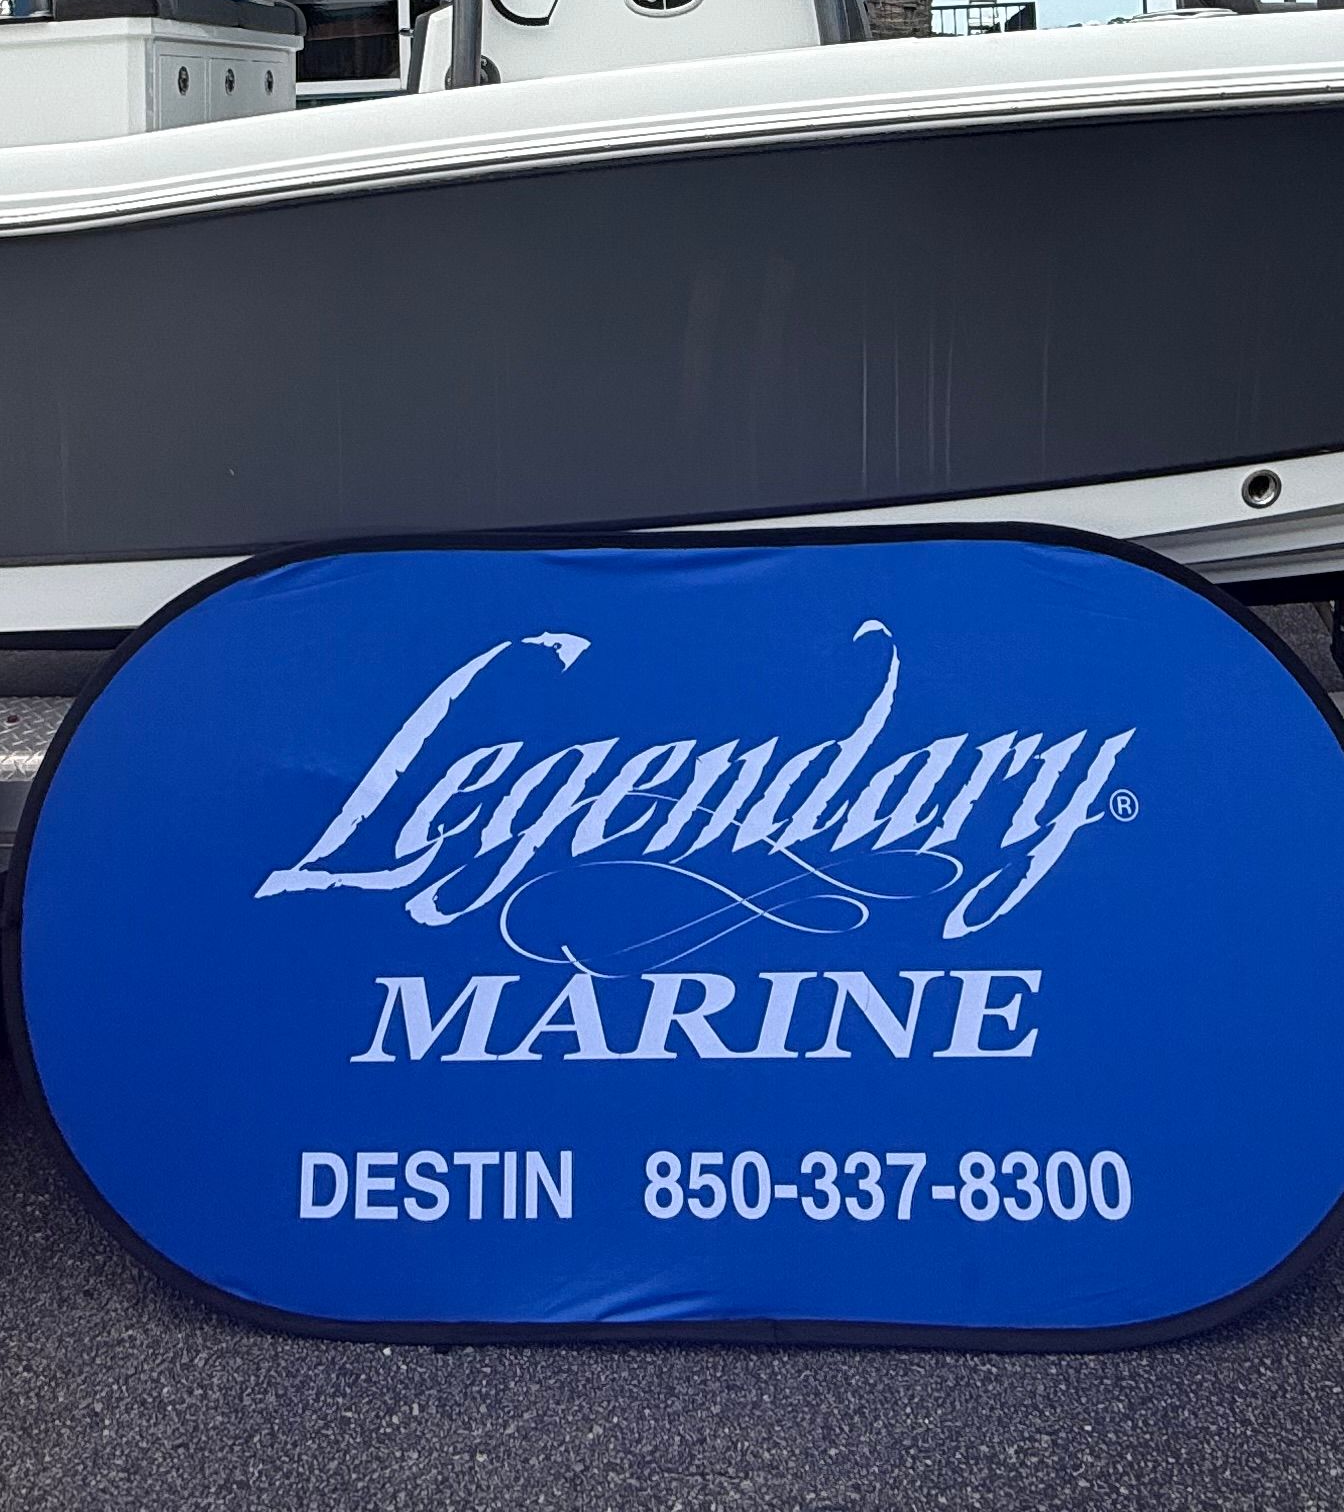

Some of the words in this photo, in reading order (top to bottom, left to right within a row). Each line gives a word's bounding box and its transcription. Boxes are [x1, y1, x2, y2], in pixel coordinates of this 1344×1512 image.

[255, 619, 1138, 940] Legendary
[349, 969, 1044, 1065] MARINE
[299, 1149, 574, 1221] DESTIN
[643, 1150, 1133, 1222] 850-337-8300
